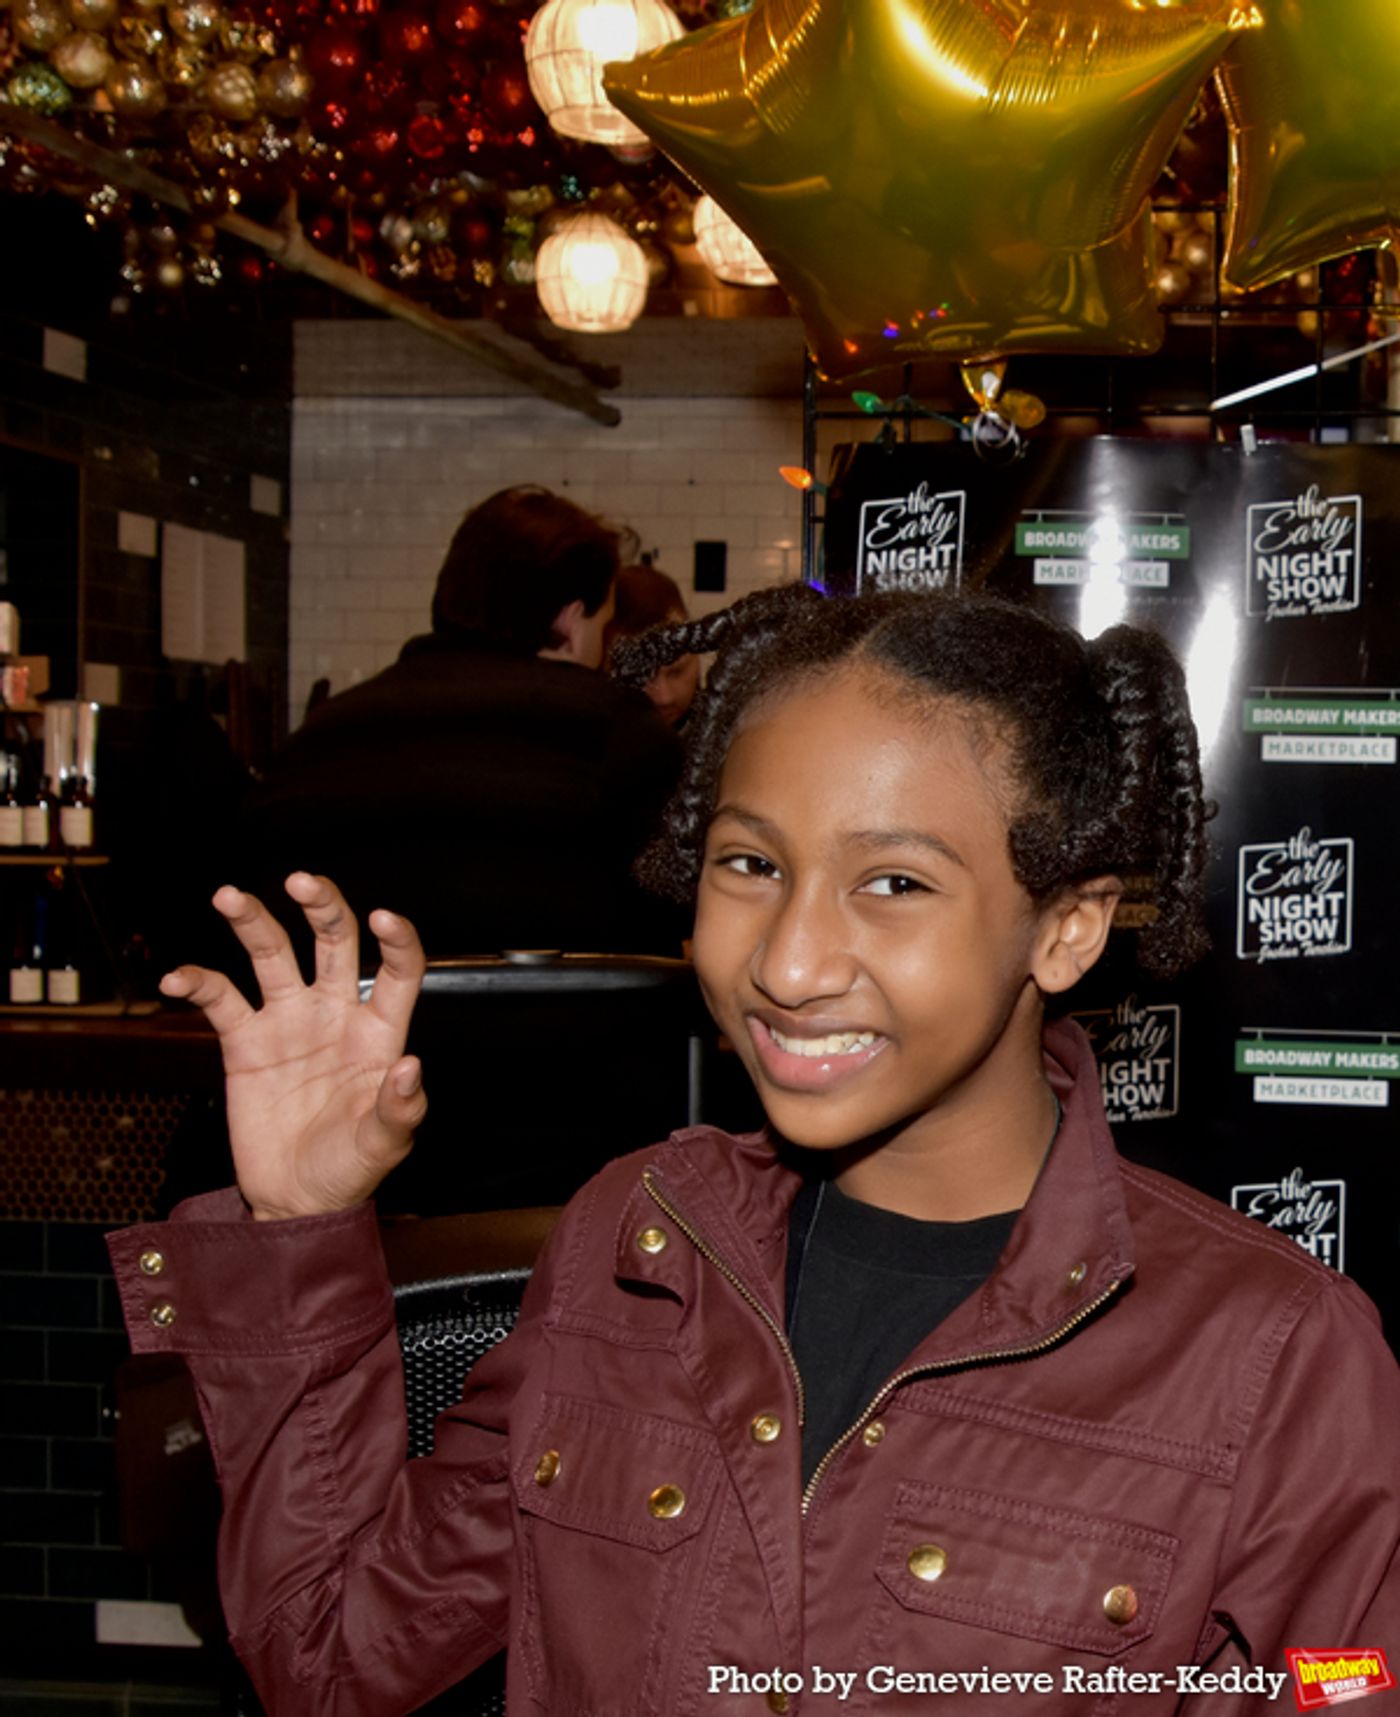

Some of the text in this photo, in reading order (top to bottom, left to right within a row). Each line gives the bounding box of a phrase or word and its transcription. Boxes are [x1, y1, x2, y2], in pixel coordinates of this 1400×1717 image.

[908, 481, 935, 514] the
[1297, 483, 1328, 518] the
[866, 502, 957, 548] Early
[1254, 506, 1353, 553] Early
[1120, 533, 1181, 550] AKERS
[867, 543, 956, 575] NIGHT
[1257, 549, 1353, 580] NIGHT
[1267, 575, 1346, 601] SHOW
[1253, 708, 1341, 725] BROADWAY
[1269, 742, 1390, 758] MARKETPLACE
[1288, 826, 1320, 859] the
[1246, 849, 1345, 895] Early
[1248, 891, 1345, 922] NIGHT
[1259, 917, 1338, 943] SHOW
[1116, 993, 1147, 1025] the
[1101, 1058, 1171, 1084] IGHT
[1244, 1048, 1399, 1070] BROADWAY MAKERS
[1103, 1082, 1165, 1107] HOW
[1260, 1083, 1380, 1100] MARKETPLACE
[1281, 1167, 1312, 1201] the
